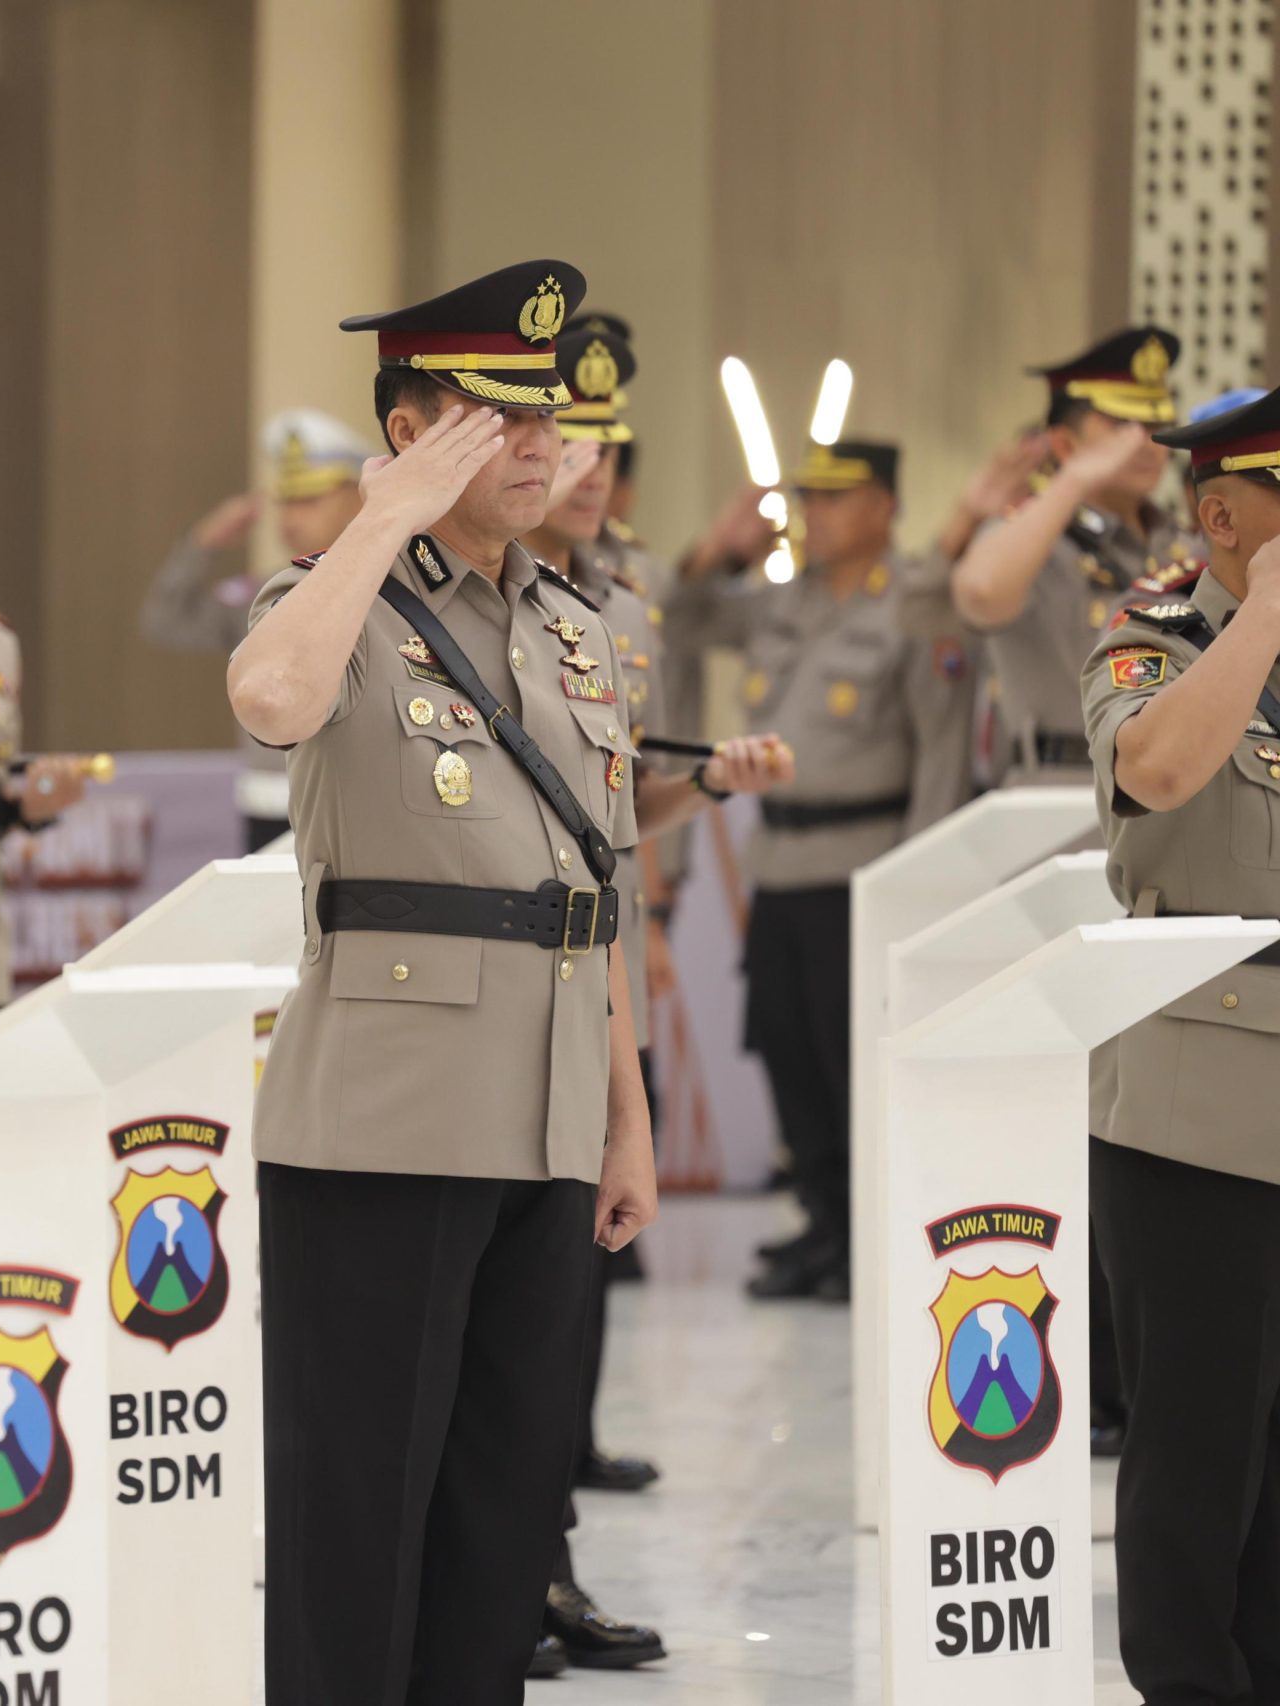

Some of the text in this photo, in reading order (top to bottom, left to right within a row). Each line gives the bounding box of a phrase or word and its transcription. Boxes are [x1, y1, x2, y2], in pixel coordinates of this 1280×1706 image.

[122, 1122, 217, 1150] JAWA TIMUR
[942, 1213, 1045, 1245] JAWA TIMUR
[109, 1385, 228, 1440] BIRO
[117, 1452, 221, 1505] SDM
[930, 1525, 1055, 1587] BIRO
[935, 1595, 1050, 1657] SDM
